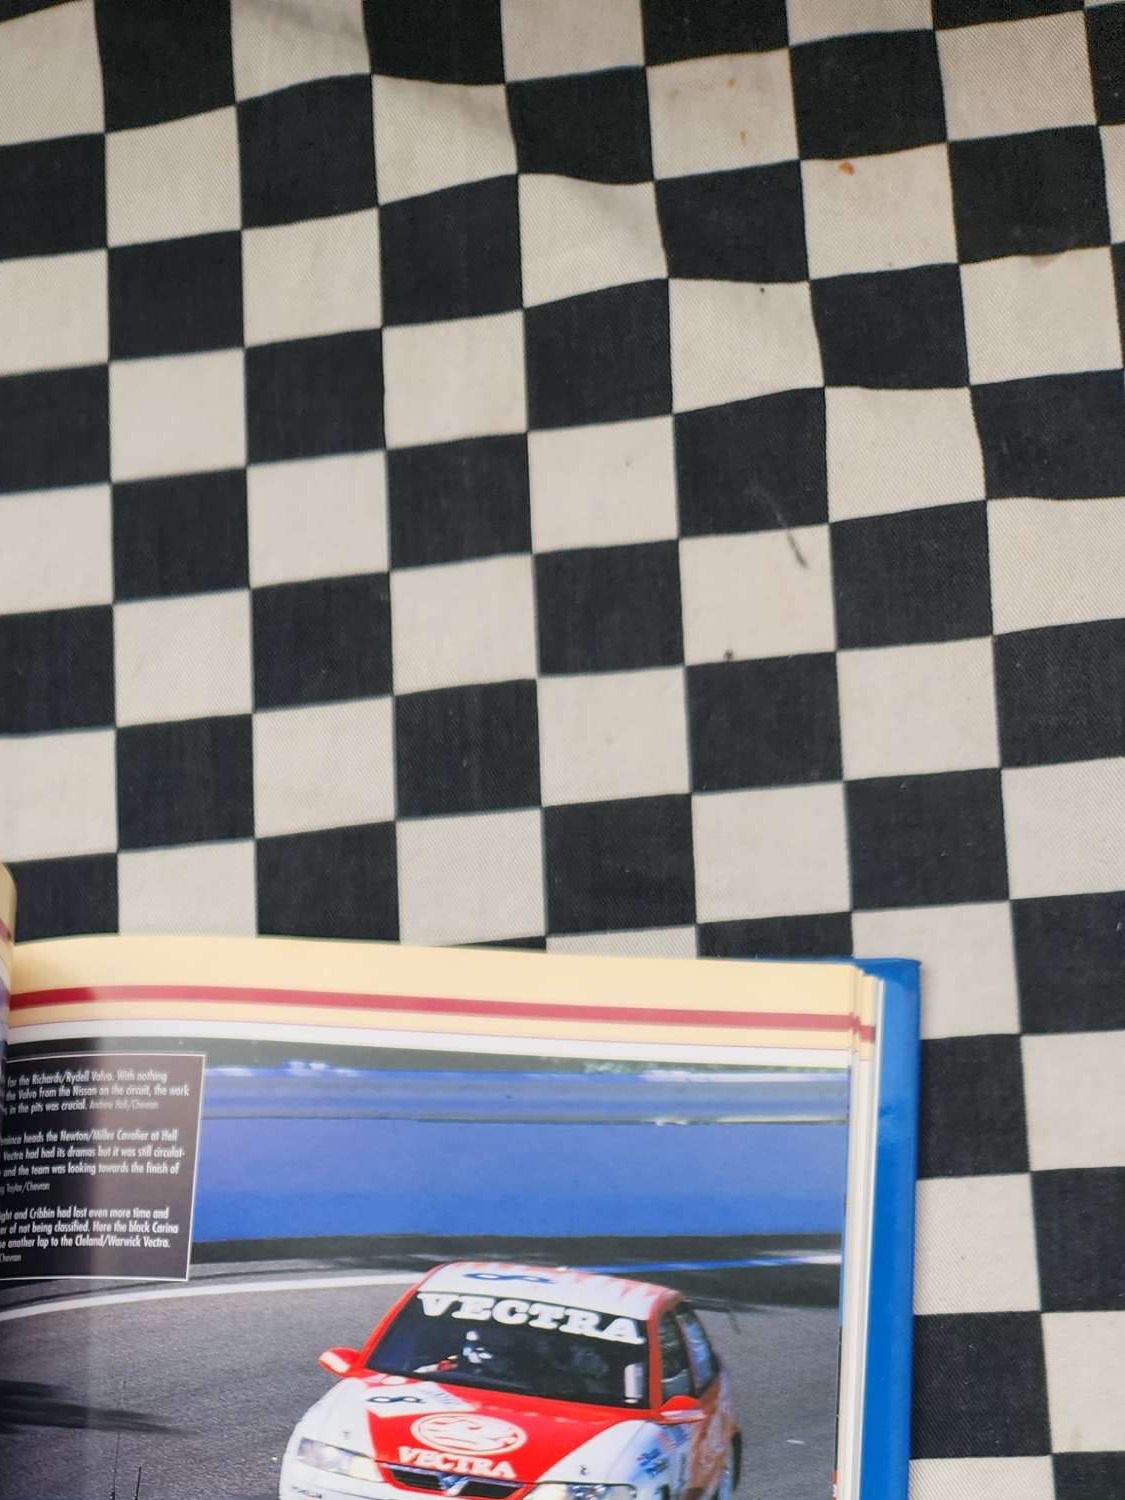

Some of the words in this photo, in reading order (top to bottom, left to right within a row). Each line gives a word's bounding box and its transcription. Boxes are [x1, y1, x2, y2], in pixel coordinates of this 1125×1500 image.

[26, 1148, 39, 1159] had
[41, 1148, 55, 1158] had
[57, 1147, 65, 1157] its
[68, 1146, 96, 1157] dramas
[98, 1146, 111, 1156] but
[121, 1148, 136, 1157] was
[138, 1145, 151, 1157] still
[19, 1224, 30, 1234] not
[32, 1222, 52, 1235] being
[54, 1221, 90, 1233] classified.
[93, 1222, 111, 1232] Here
[114, 1221, 126, 1232] the
[129, 1221, 150, 1232] black
[152, 1222, 179, 1233] Carina
[8, 1237, 35, 1248] another
[37, 1235, 48, 1249] lap
[51, 1237, 59, 1247] to
[61, 1236, 72, 1247] the
[75, 1235, 140, 1247] Cleland/Warwick
[144, 1236, 170, 1248] Vectra.
[417, 1291, 646, 1345] VECTRA
[397, 1445, 517, 1480] VECTRA
